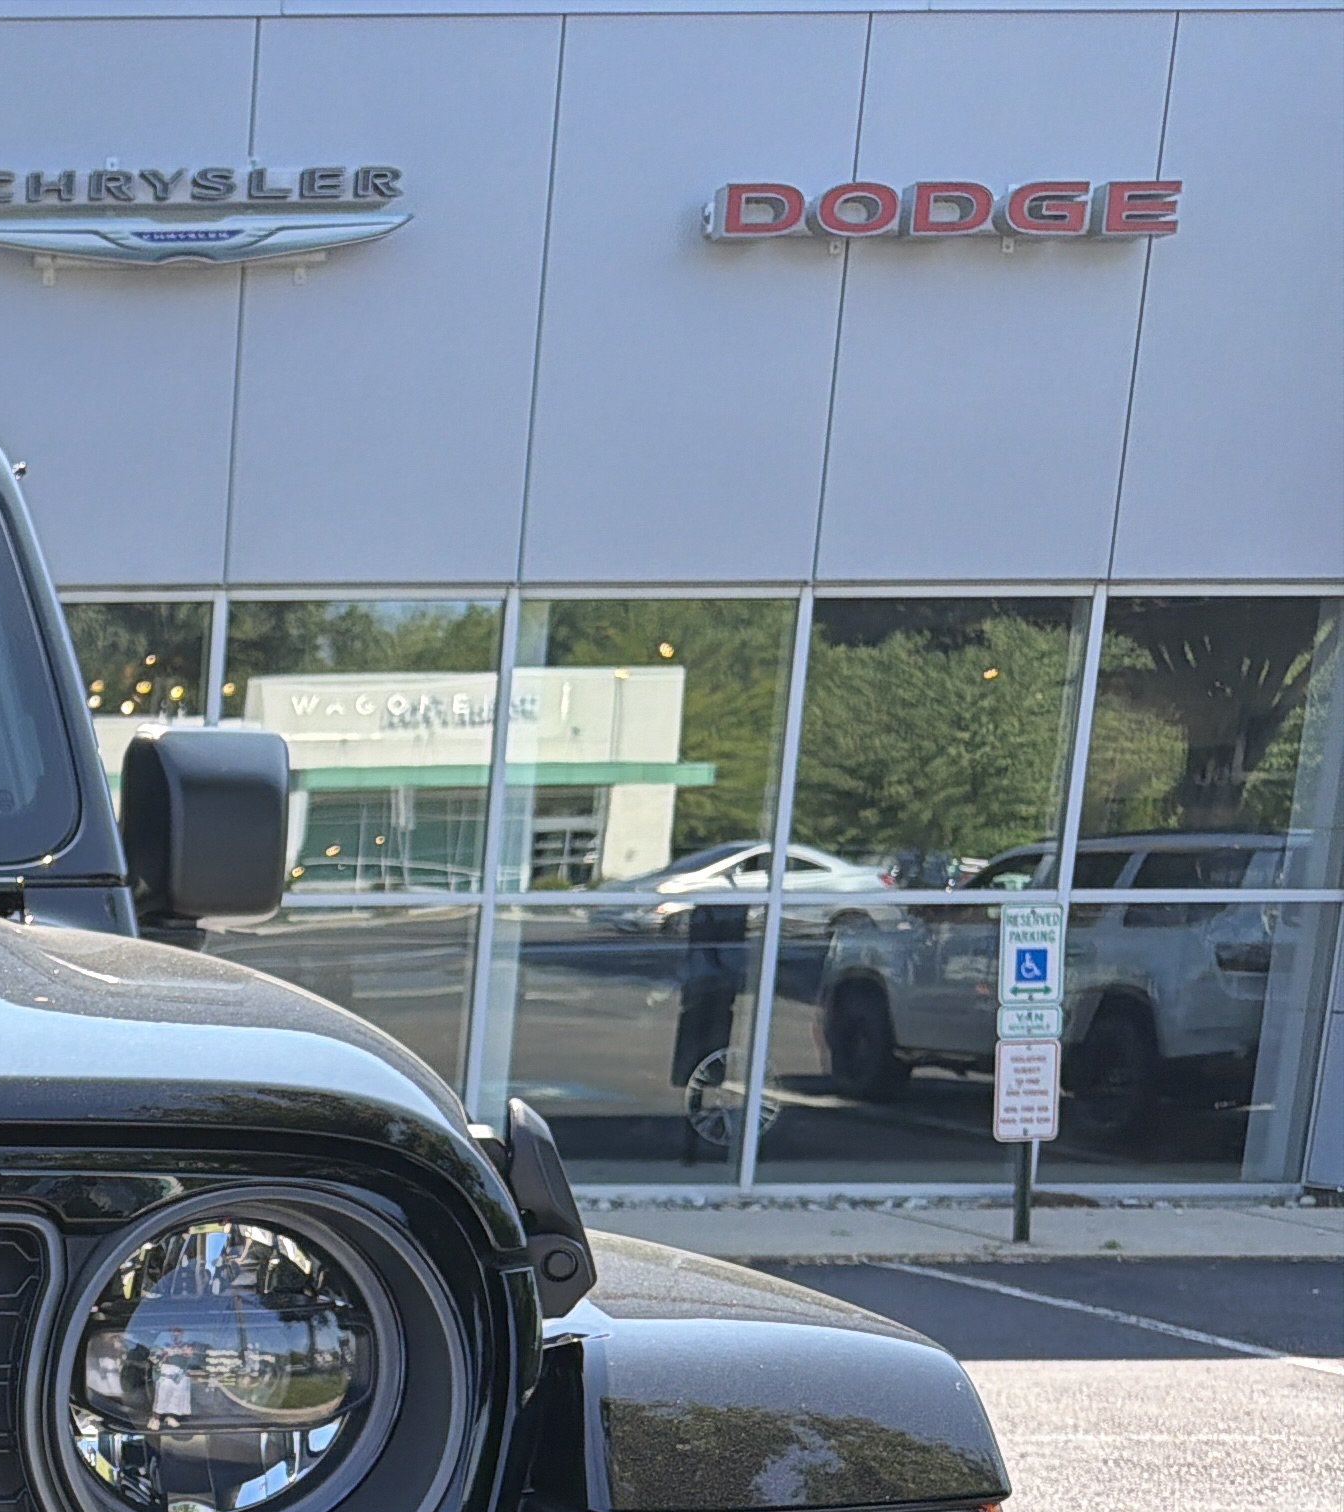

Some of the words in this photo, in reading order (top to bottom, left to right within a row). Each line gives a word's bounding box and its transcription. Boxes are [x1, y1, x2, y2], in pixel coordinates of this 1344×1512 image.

[716, 180, 1183, 236] DODGE
[1006, 912, 1061, 927] RESERVED
[1008, 929, 1056, 944] PARKING
